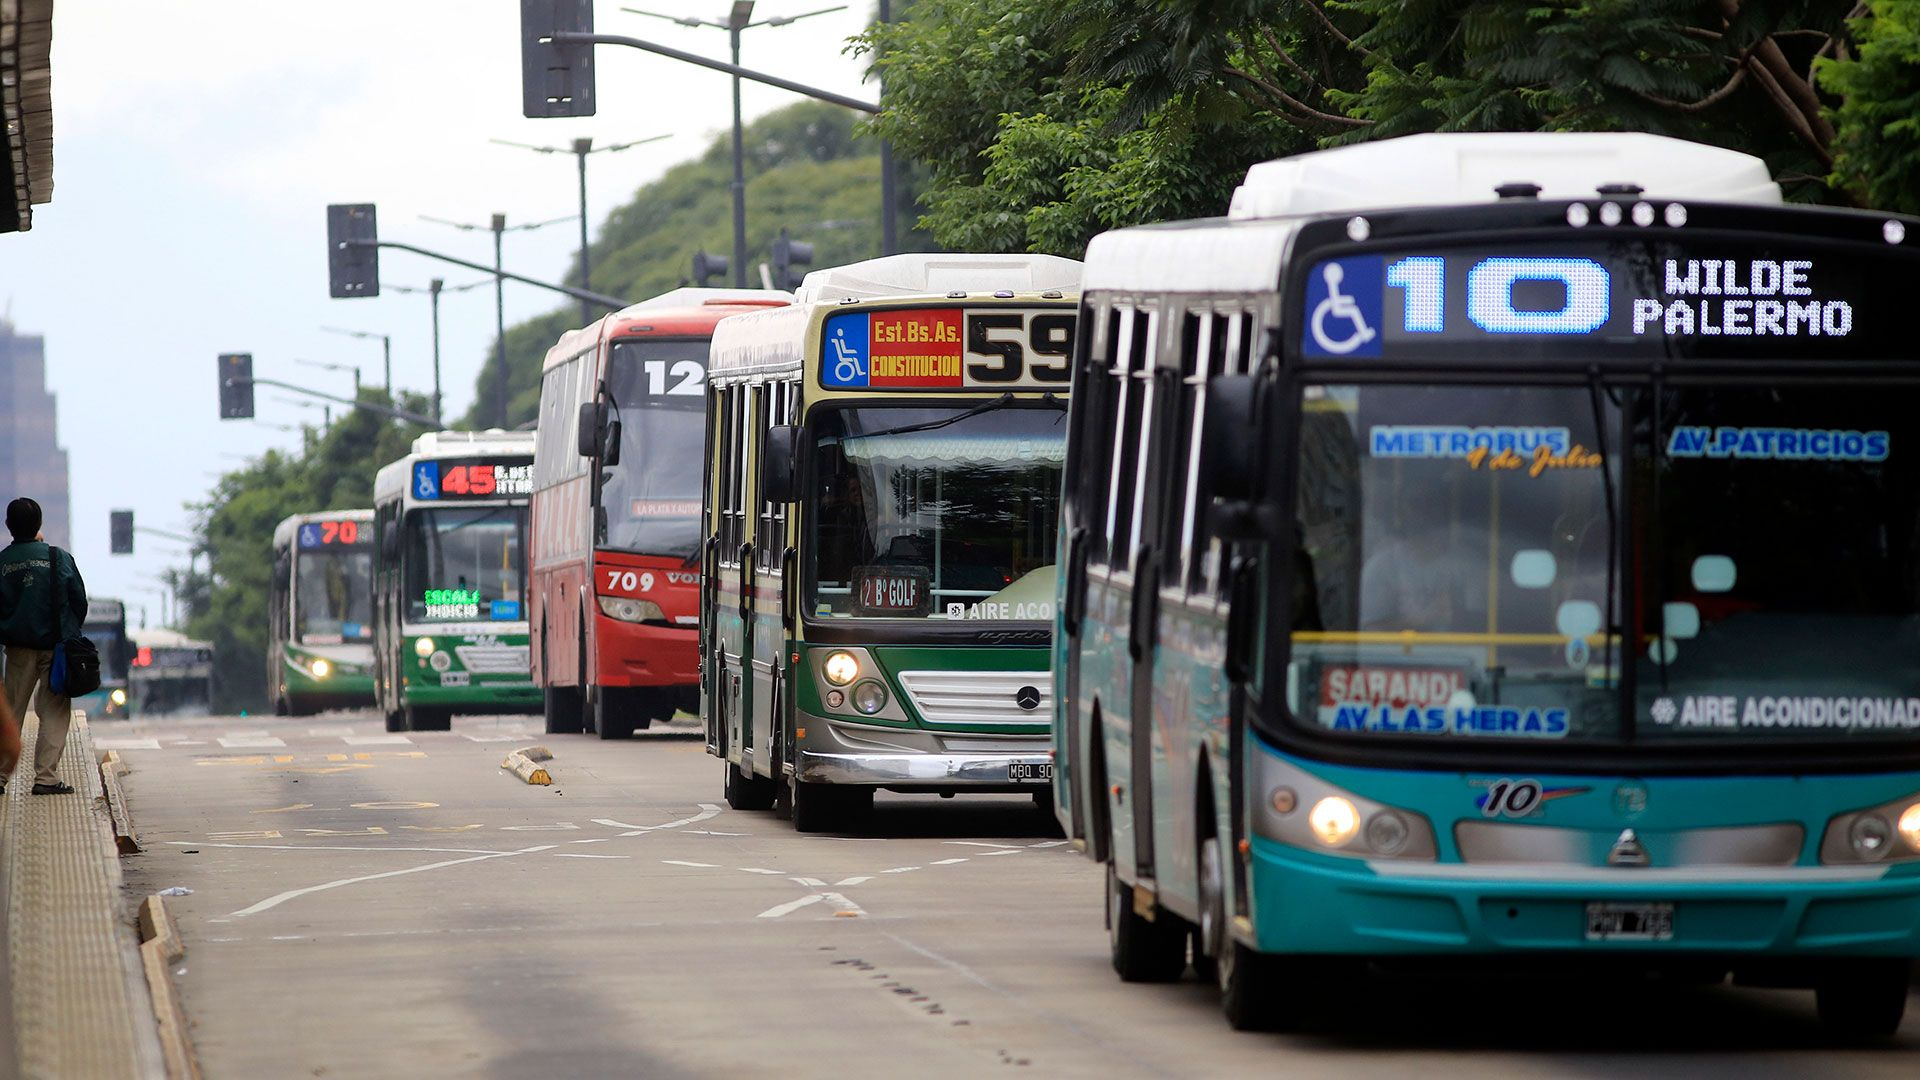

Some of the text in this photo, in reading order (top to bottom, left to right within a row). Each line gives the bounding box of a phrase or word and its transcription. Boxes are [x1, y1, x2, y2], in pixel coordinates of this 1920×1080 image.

[1665, 259, 1813, 296] WILDE
[1387, 256, 1610, 334] 10
[874, 321, 961, 344] Est.Bs.As.
[1633, 299, 1853, 336] PALERMO
[967, 313, 1078, 383] 59
[644, 360, 705, 396] 12
[871, 355, 961, 378] CONSTITUCION
[1372, 427, 1569, 456] METROBUS
[1669, 427, 1889, 460] AV.PATRICIOS
[1528, 445, 1603, 478] Julio
[441, 465, 496, 495] 45
[321, 520, 357, 545] 70
[608, 571, 654, 592] 709
[889, 579, 916, 606] GOLF
[969, 603, 1009, 620] AIRE
[1455, 706, 1569, 734] HERAS
[1680, 696, 1738, 727] AIRE
[1010, 764, 1031, 778] MBQ
[1484, 781, 1540, 815] 10
